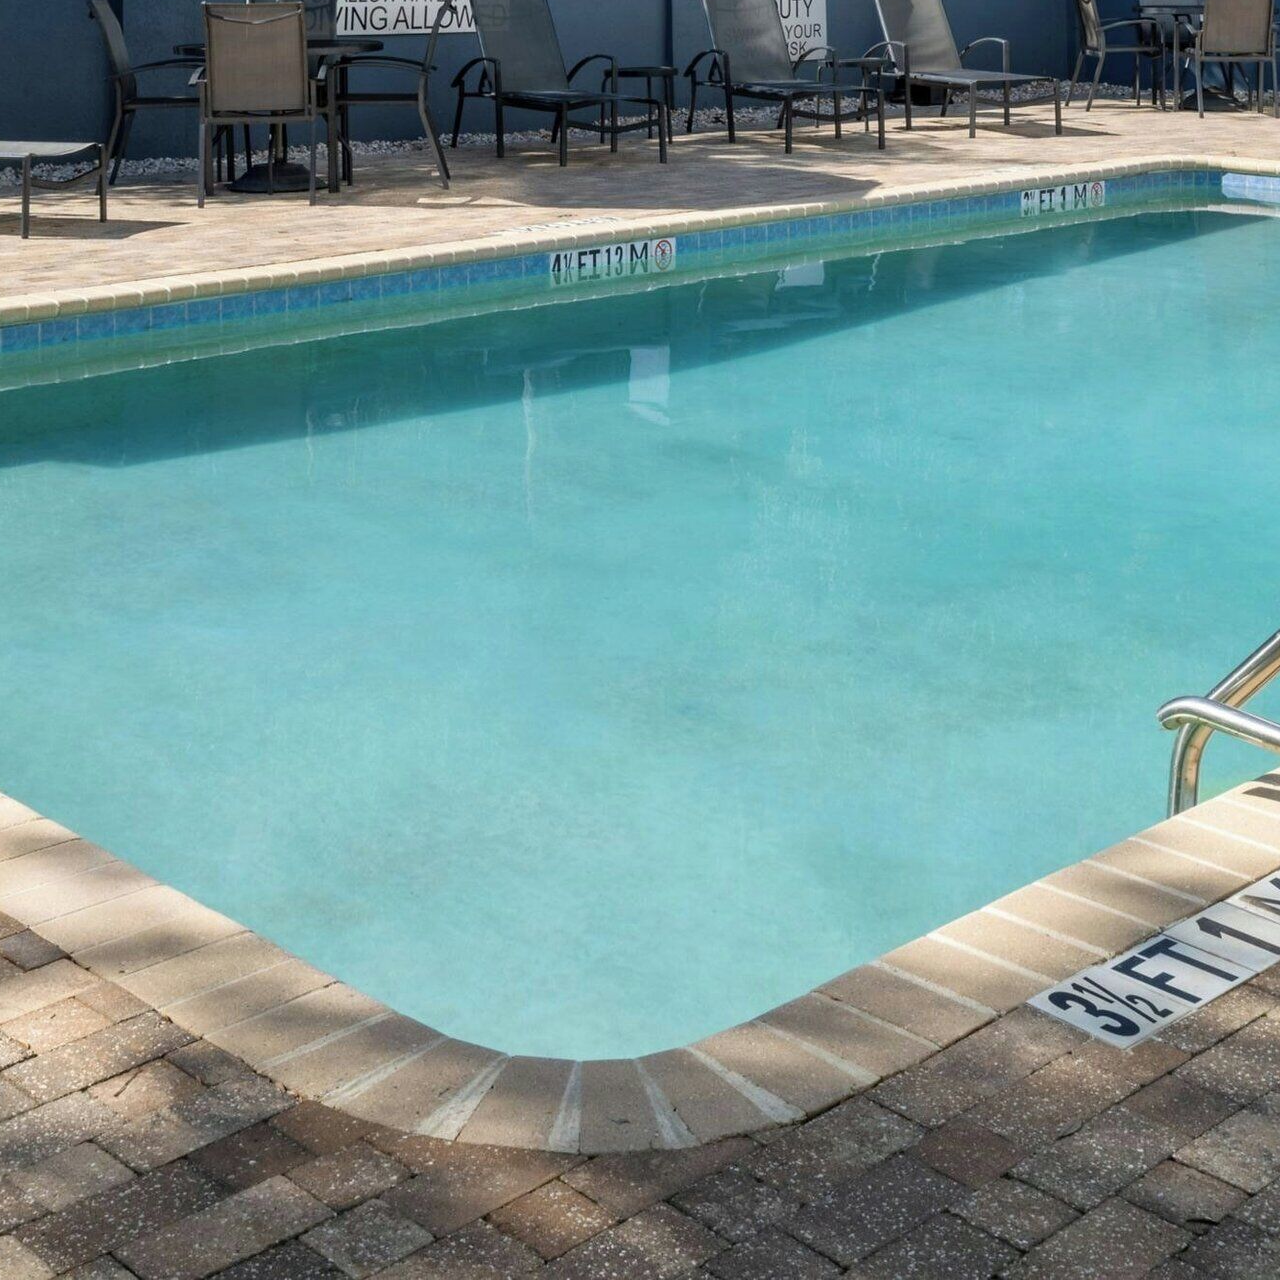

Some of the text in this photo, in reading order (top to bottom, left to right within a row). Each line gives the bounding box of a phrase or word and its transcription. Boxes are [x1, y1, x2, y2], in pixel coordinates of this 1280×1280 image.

[785, 23, 822, 39] YOUR
[787, 41, 809, 56] SK
[629, 242, 649, 262] M
[1114, 937, 1239, 1004] FT
